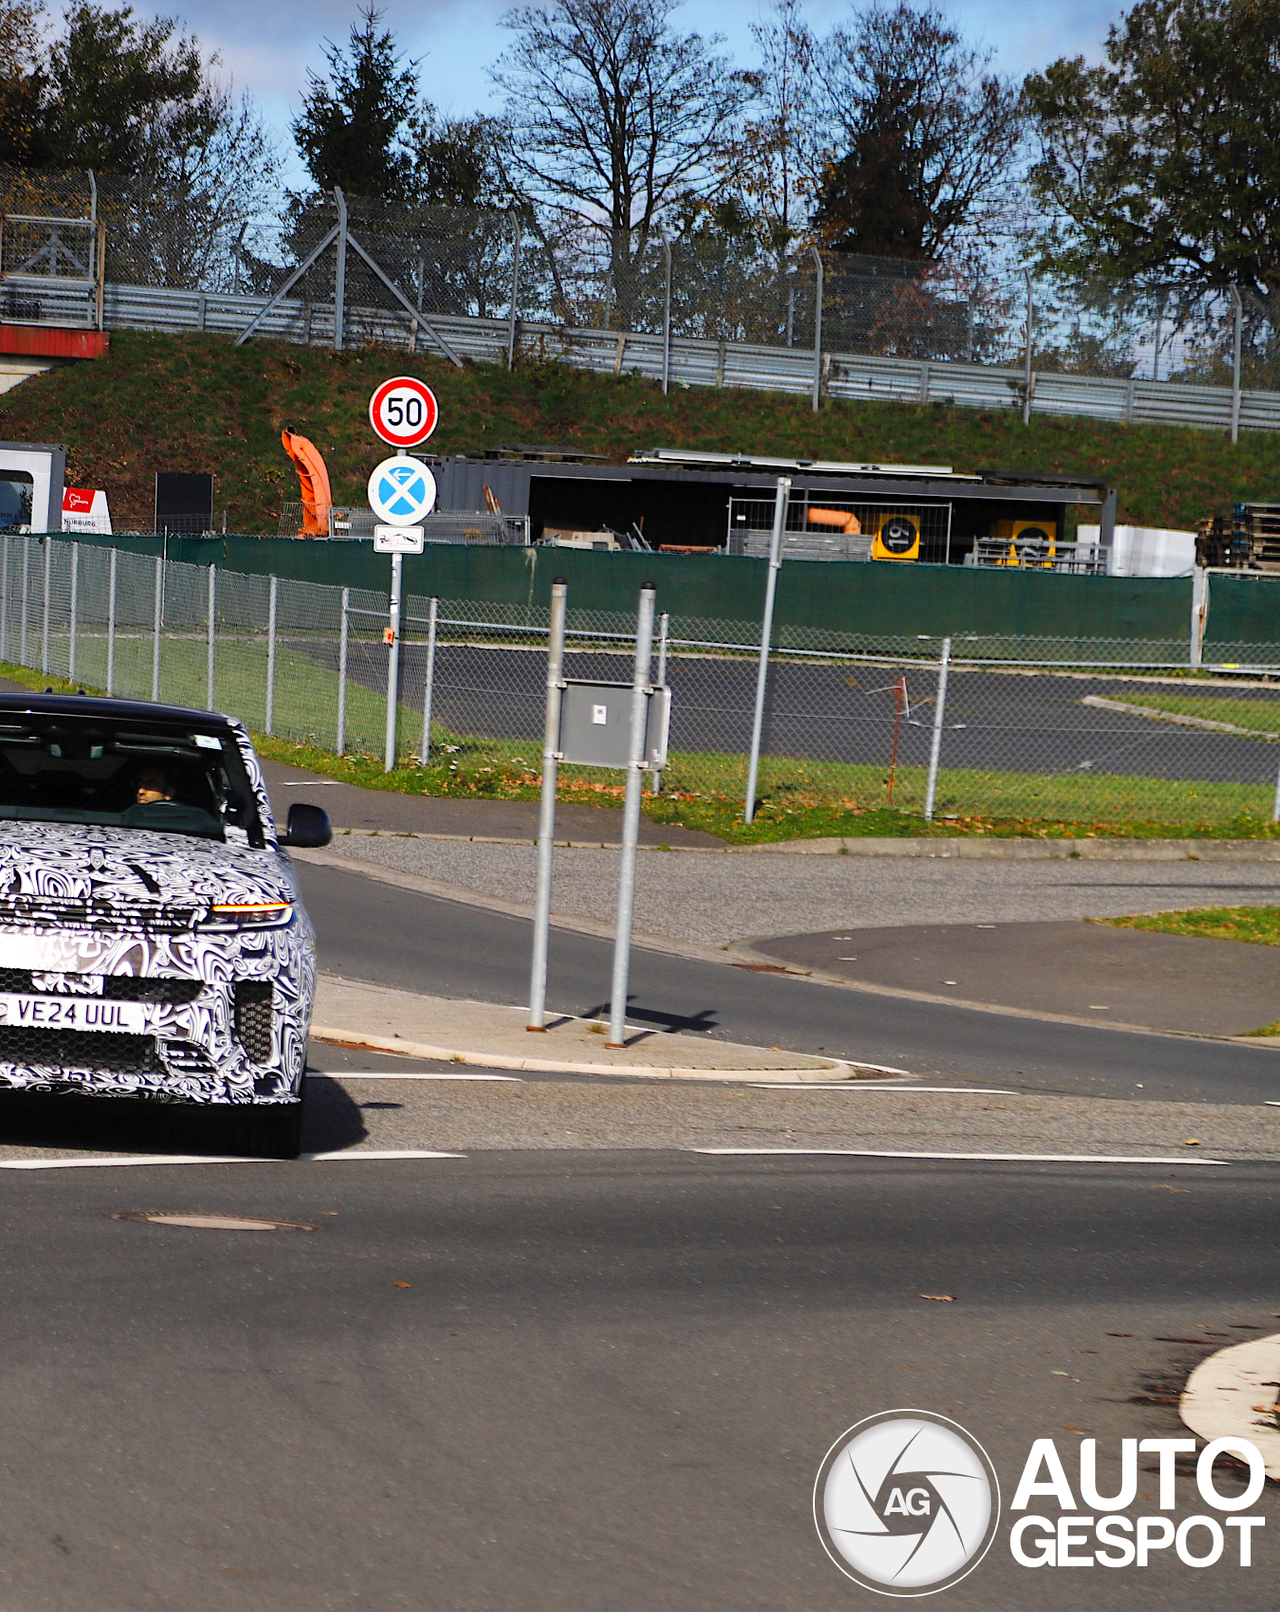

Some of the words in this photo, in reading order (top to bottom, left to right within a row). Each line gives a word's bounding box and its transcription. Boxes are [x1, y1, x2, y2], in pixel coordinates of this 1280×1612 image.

[387, 397, 422, 426] 50
[18, 999, 76, 1024] VE24
[85, 1004, 129, 1027] UUL
